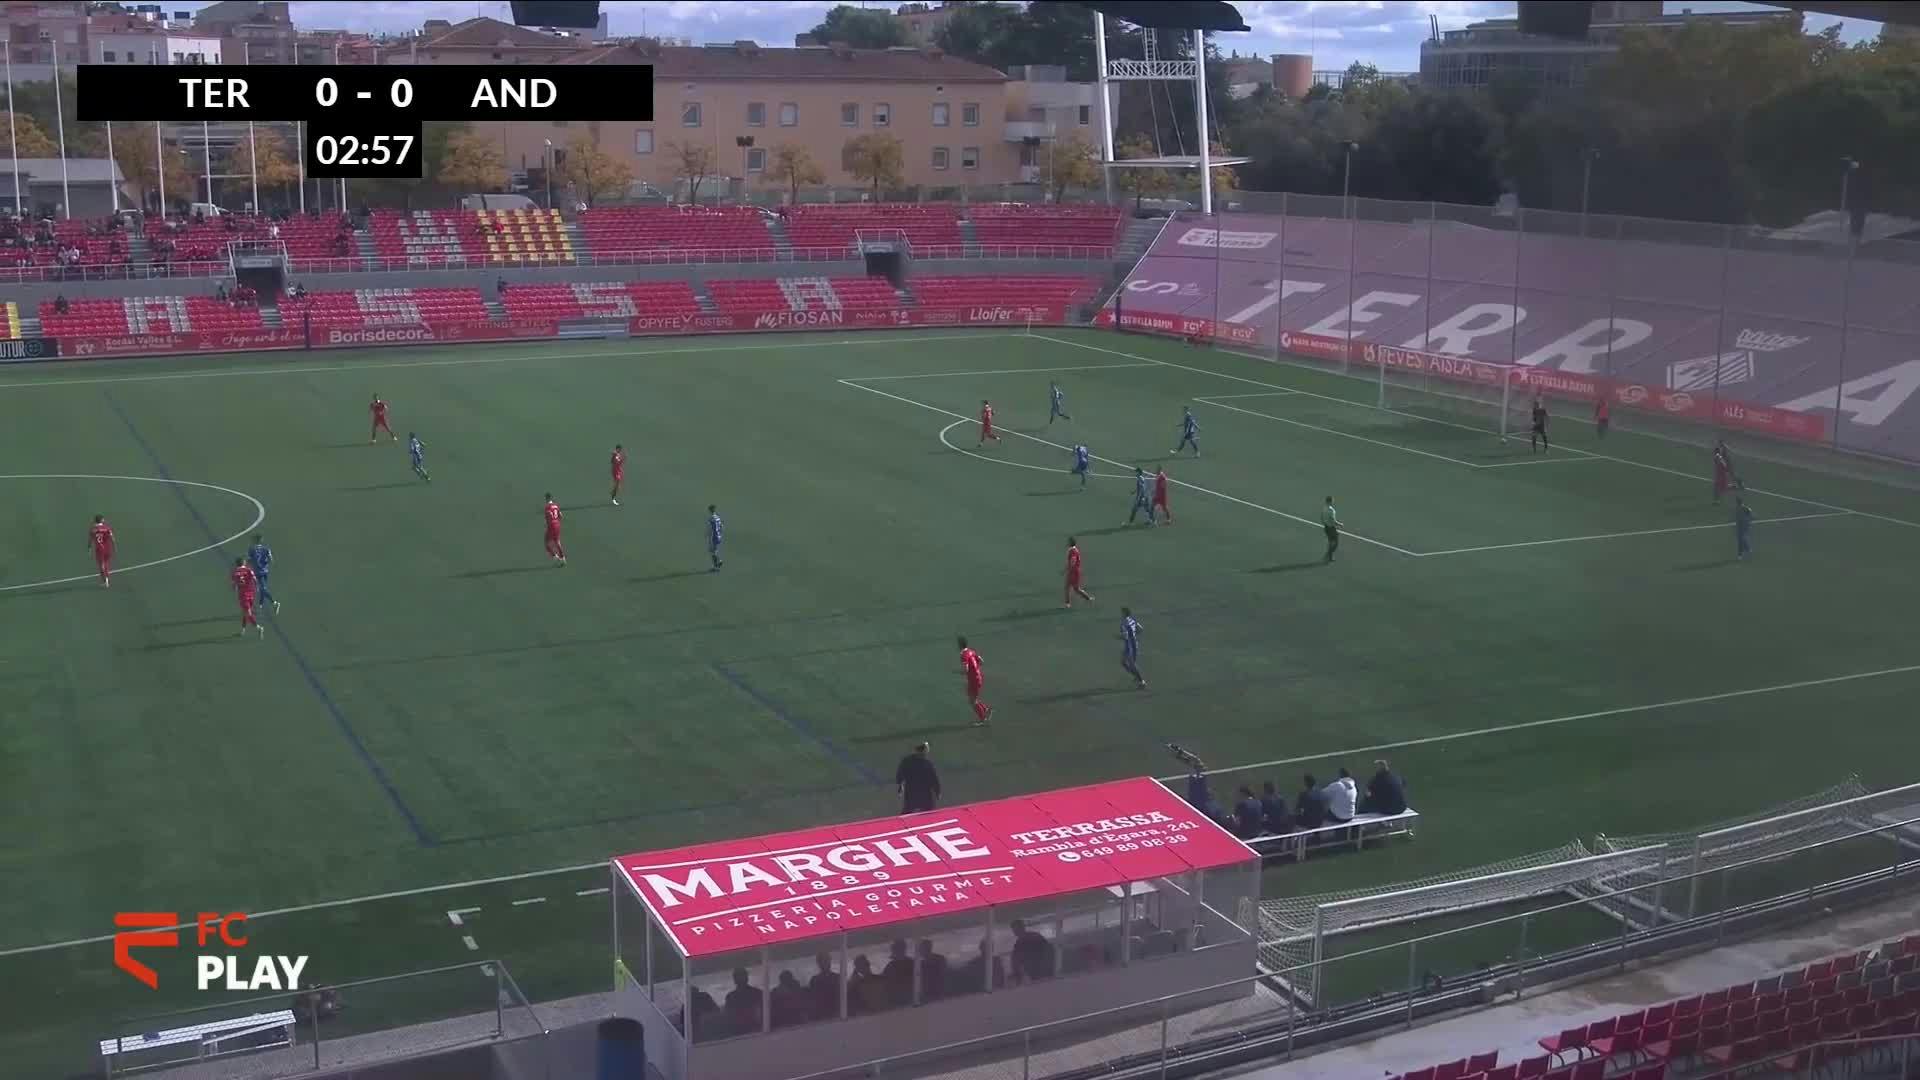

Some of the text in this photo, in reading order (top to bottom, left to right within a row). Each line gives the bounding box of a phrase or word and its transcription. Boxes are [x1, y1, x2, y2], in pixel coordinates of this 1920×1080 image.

[779, 311, 843, 325] FIOSAN
[329, 328, 425, 343] Borisdecor
[1010, 841, 1088, 858] Rambla
[1167, 820, 1201, 832] 241
[1011, 811, 1173, 845] TERRASSA
[1082, 833, 1189, 859] 649 89 08 39
[639, 827, 992, 909] MARGHE
[784, 872, 891, 896] 1889
[690, 874, 1013, 936] PIZZERIA GOURMET
[758, 891, 970, 935] NAPOLETANA
